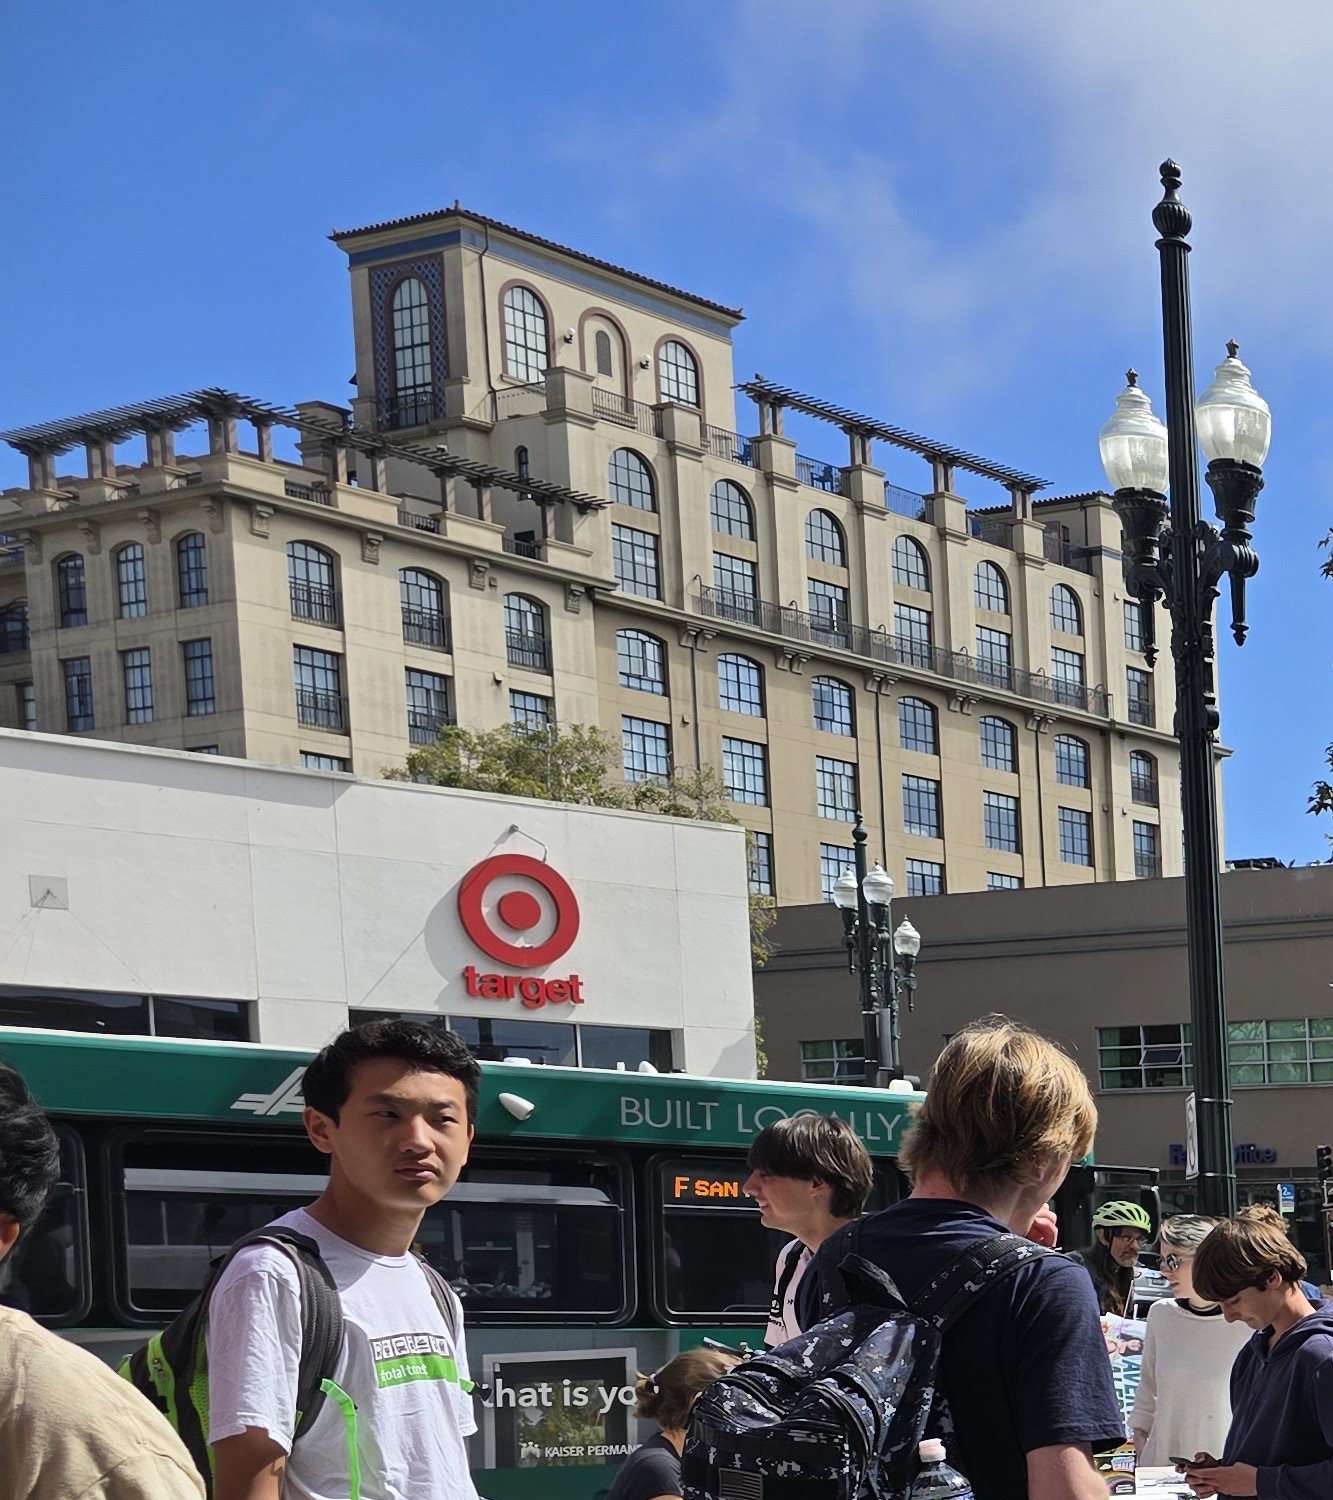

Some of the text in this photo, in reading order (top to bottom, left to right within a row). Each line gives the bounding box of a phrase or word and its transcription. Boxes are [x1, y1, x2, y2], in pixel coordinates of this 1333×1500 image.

[462, 965, 585, 1009] target
[620, 1096, 902, 1141] BUILT LOLLY
[1234, 1143, 1278, 1164] ffice
[674, 1176, 739, 1198] F SAN
[562, 1378, 589, 1407] is
[544, 1445, 585, 1457] KAISER
